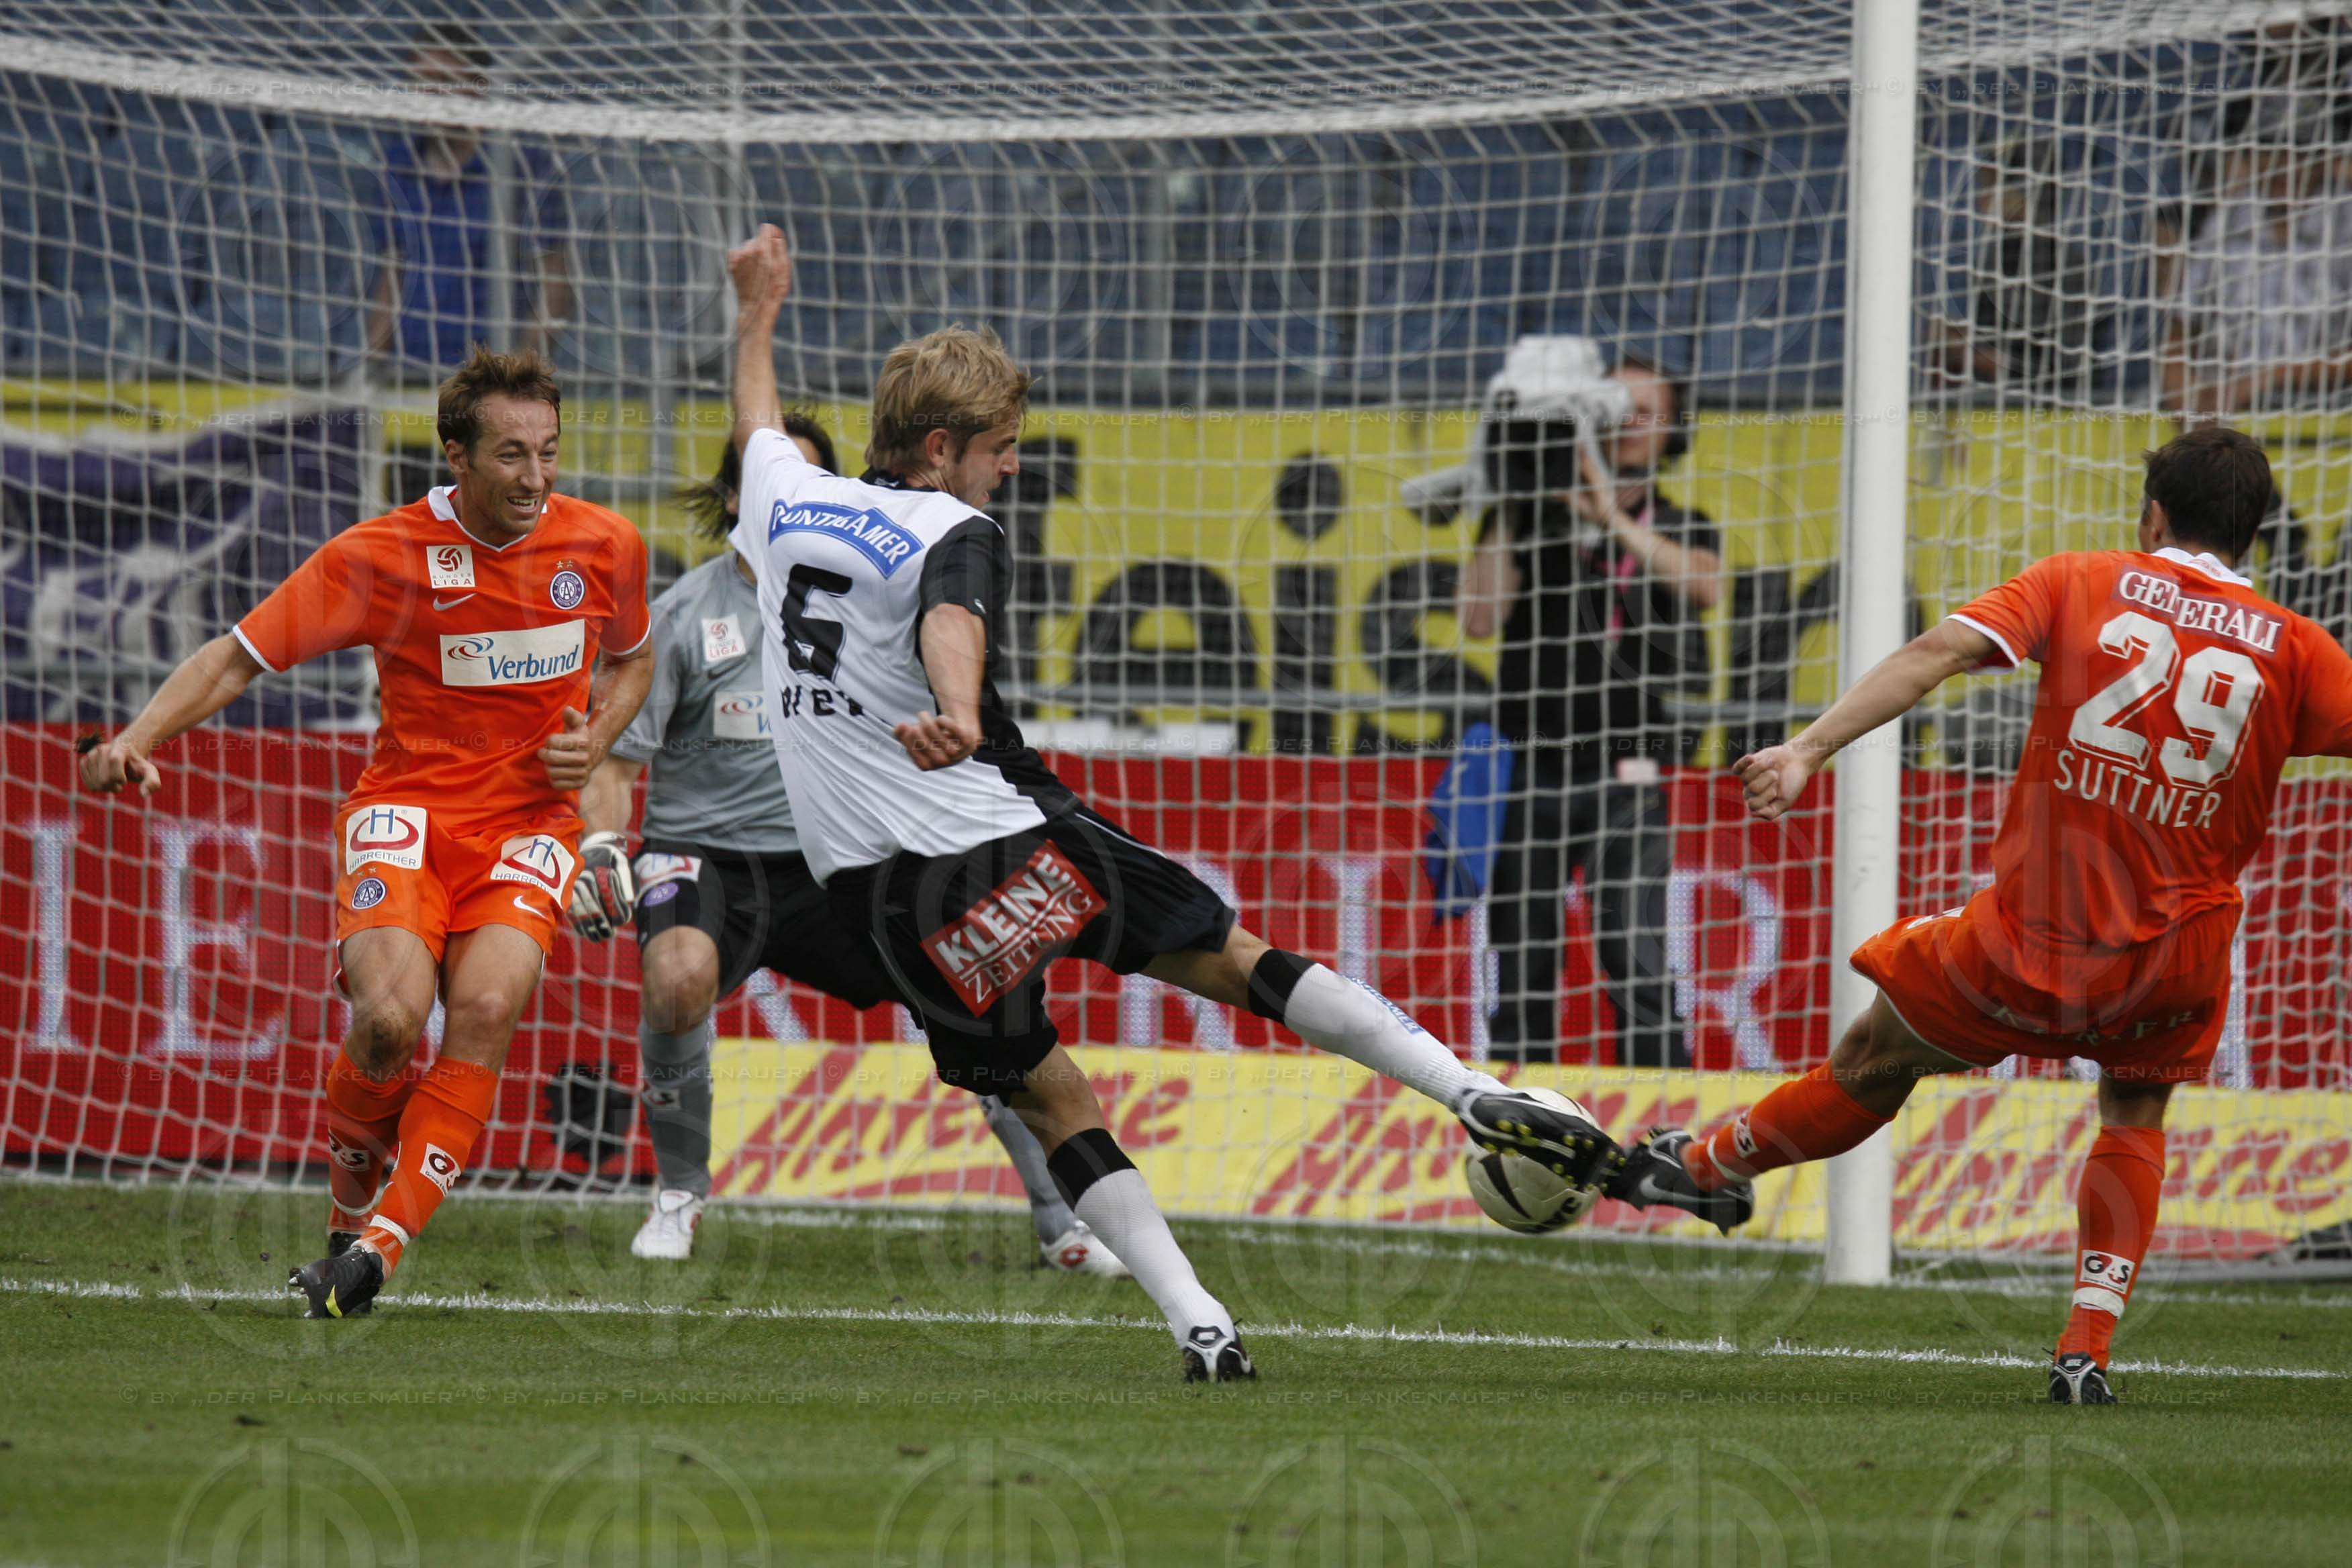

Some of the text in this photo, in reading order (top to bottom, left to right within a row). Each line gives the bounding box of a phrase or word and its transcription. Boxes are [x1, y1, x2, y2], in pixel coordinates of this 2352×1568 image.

[487, 644, 579, 680] Verbund
[779, 563, 853, 683] 6
[2067, 611, 2266, 791] 29
[2053, 749, 2222, 829] SUTTNER
[349, 850, 417, 871] HARREITHER
[935, 853, 1071, 973] KLEINE
[964, 888, 1093, 1004] ZEITUNG
[2084, 1254, 2130, 1285] G4S
